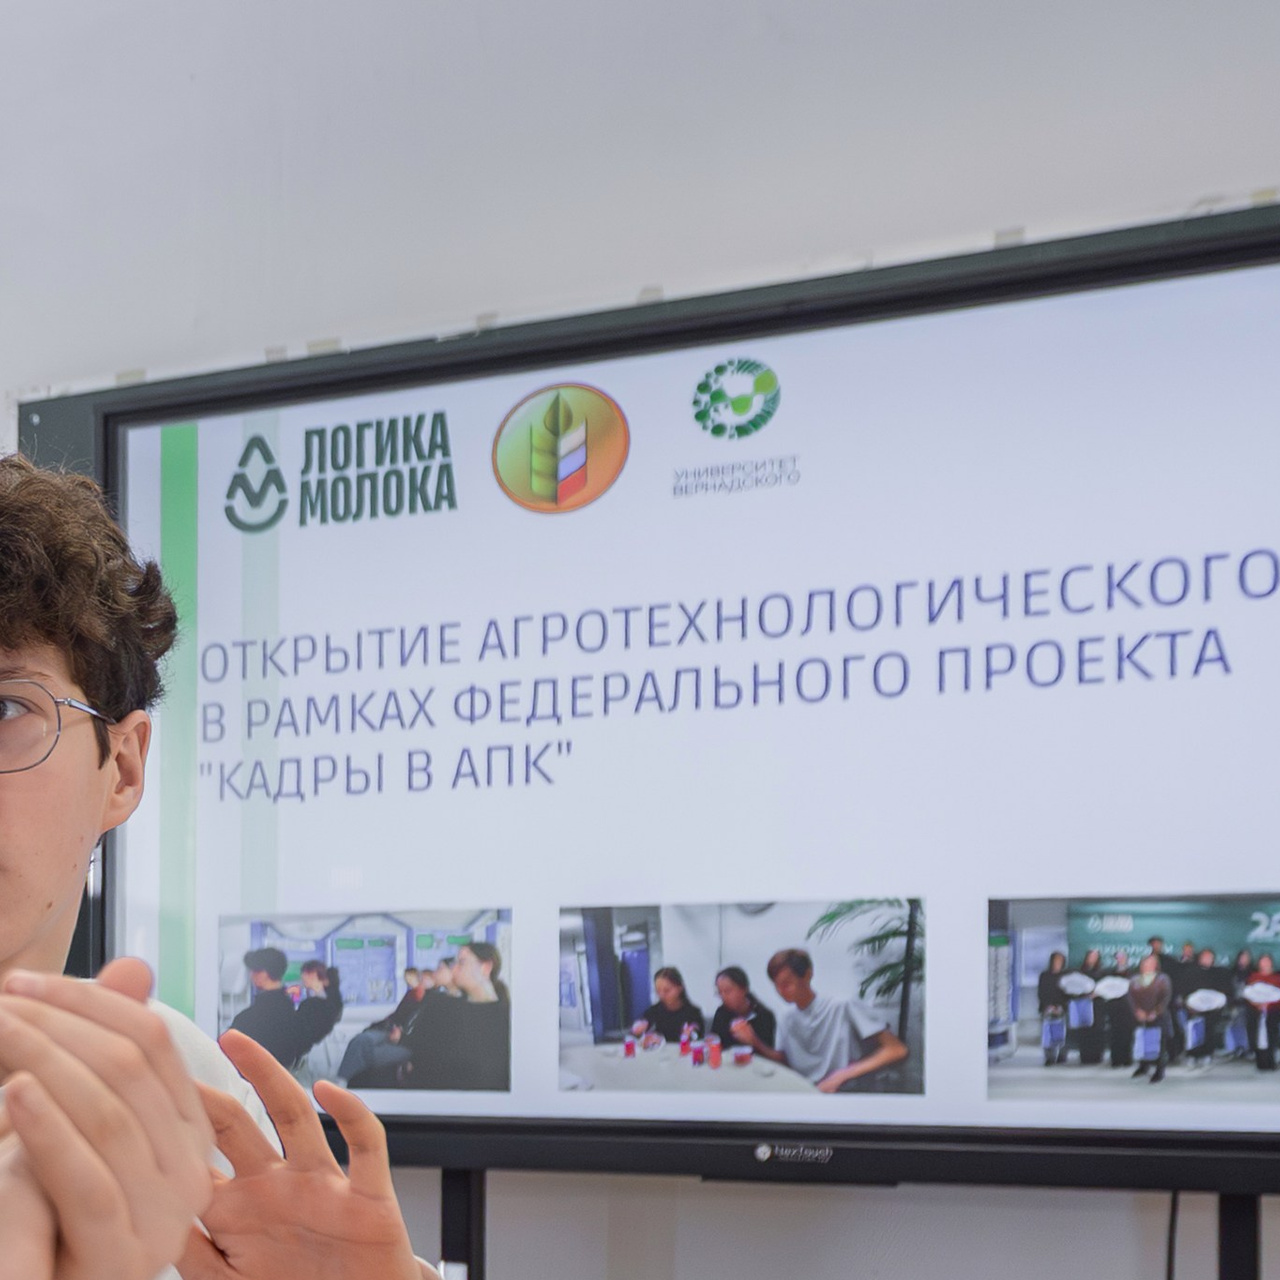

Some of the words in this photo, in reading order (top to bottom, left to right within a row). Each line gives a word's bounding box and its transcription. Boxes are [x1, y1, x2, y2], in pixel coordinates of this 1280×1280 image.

[300, 410, 451, 475] ЛОГИКА
[298, 462, 458, 527] МОЛОКА
[200, 621, 462, 684] ОТКРЫТИЕ
[477, 548, 1280, 662] АГРОТЕХНОЛОГИЧЕСКОГО
[201, 702, 226, 743] В
[246, 686, 436, 739] РАМКАХ
[452, 651, 911, 726] ФЕДЕРАЛЬНОГО
[937, 627, 1232, 695] ПРОЕКТА
[199, 752, 384, 803] "КАДРЫ
[407, 749, 433, 792] В
[450, 740, 573, 790] АПК"
